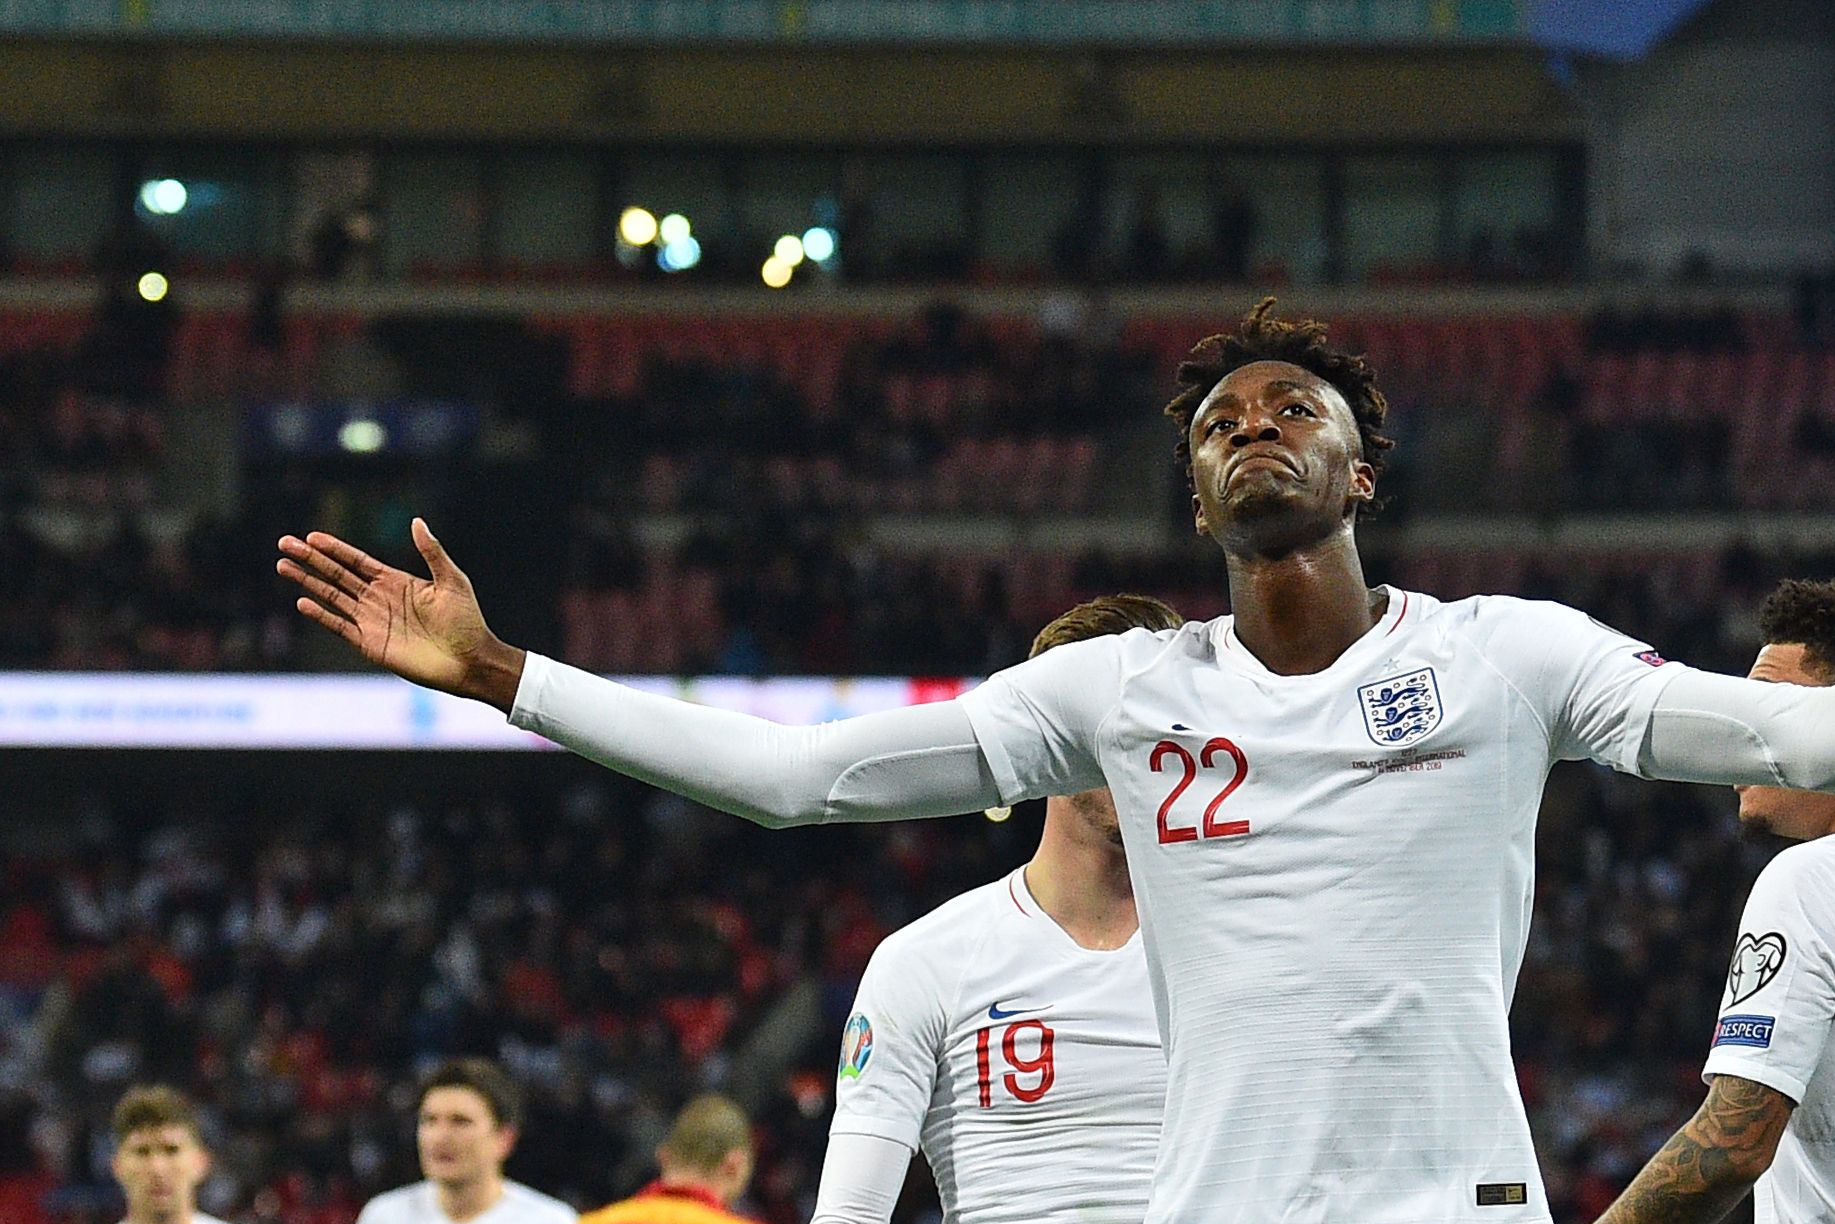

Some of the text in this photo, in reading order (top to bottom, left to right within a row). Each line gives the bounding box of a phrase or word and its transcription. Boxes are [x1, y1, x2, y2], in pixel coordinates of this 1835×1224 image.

[1150, 737, 1250, 844] 22
[976, 1019, 1056, 1108] 19
[1719, 1022, 1772, 1040] RESPECT
